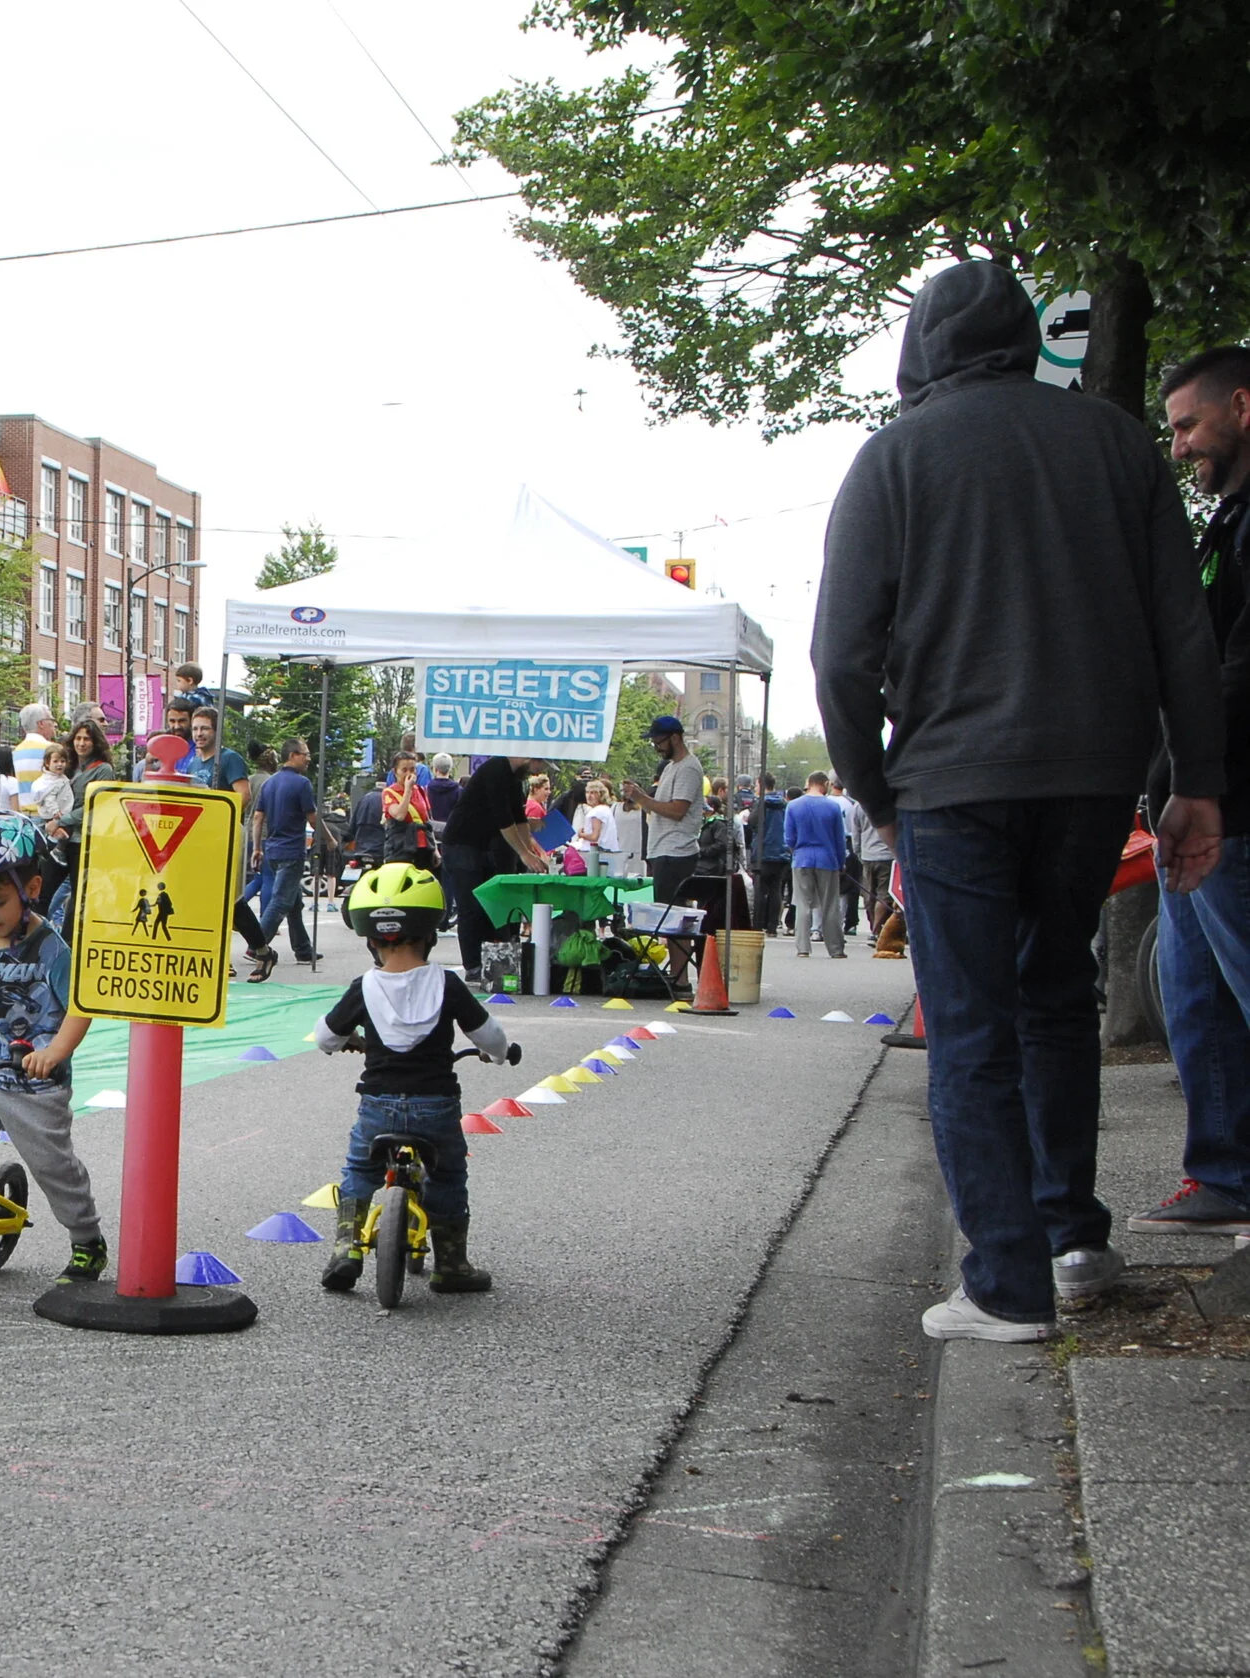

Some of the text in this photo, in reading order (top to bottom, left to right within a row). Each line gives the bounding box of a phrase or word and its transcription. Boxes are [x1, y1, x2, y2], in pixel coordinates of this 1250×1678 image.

[236, 623, 346, 638] parallelrentals.com
[432, 668, 601, 702] STREETS
[505, 700, 527, 709] FOR
[431, 703, 597, 739] EVERYONE
[87, 948, 213, 978] PEDESTRIAN
[97, 975, 199, 1004] CROSSING
